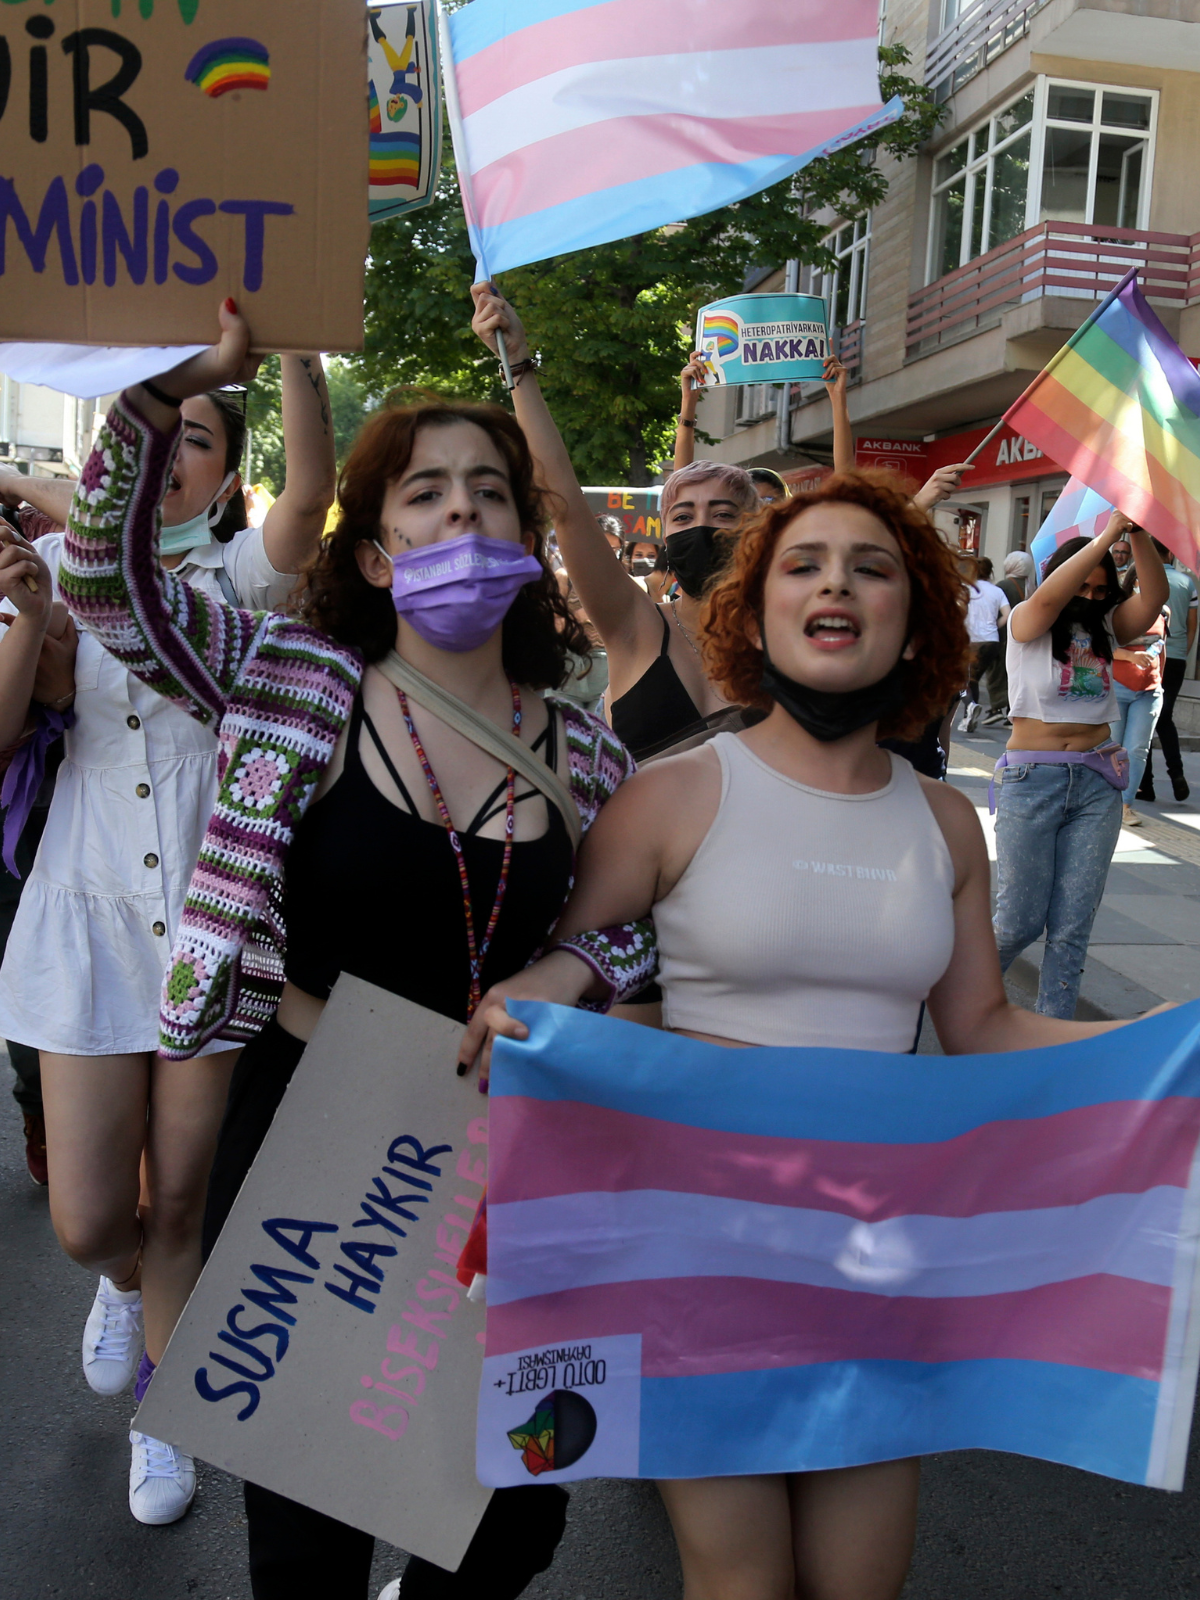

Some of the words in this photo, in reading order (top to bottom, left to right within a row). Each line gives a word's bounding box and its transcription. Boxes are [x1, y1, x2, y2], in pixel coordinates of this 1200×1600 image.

[741, 322, 825, 338] HETEROPATRİYARKAYA
[743, 338, 825, 363] NAKKA!
[862, 440, 922, 452] AKBANK
[607, 491, 635, 509] BE
[324, 1134, 454, 1314] HAYKIR
[194, 1217, 339, 1422] SUSMA
[517, 1345, 591, 1371] DAYANIŞMASI
[563, 1359, 606, 1389] ODTÜ
